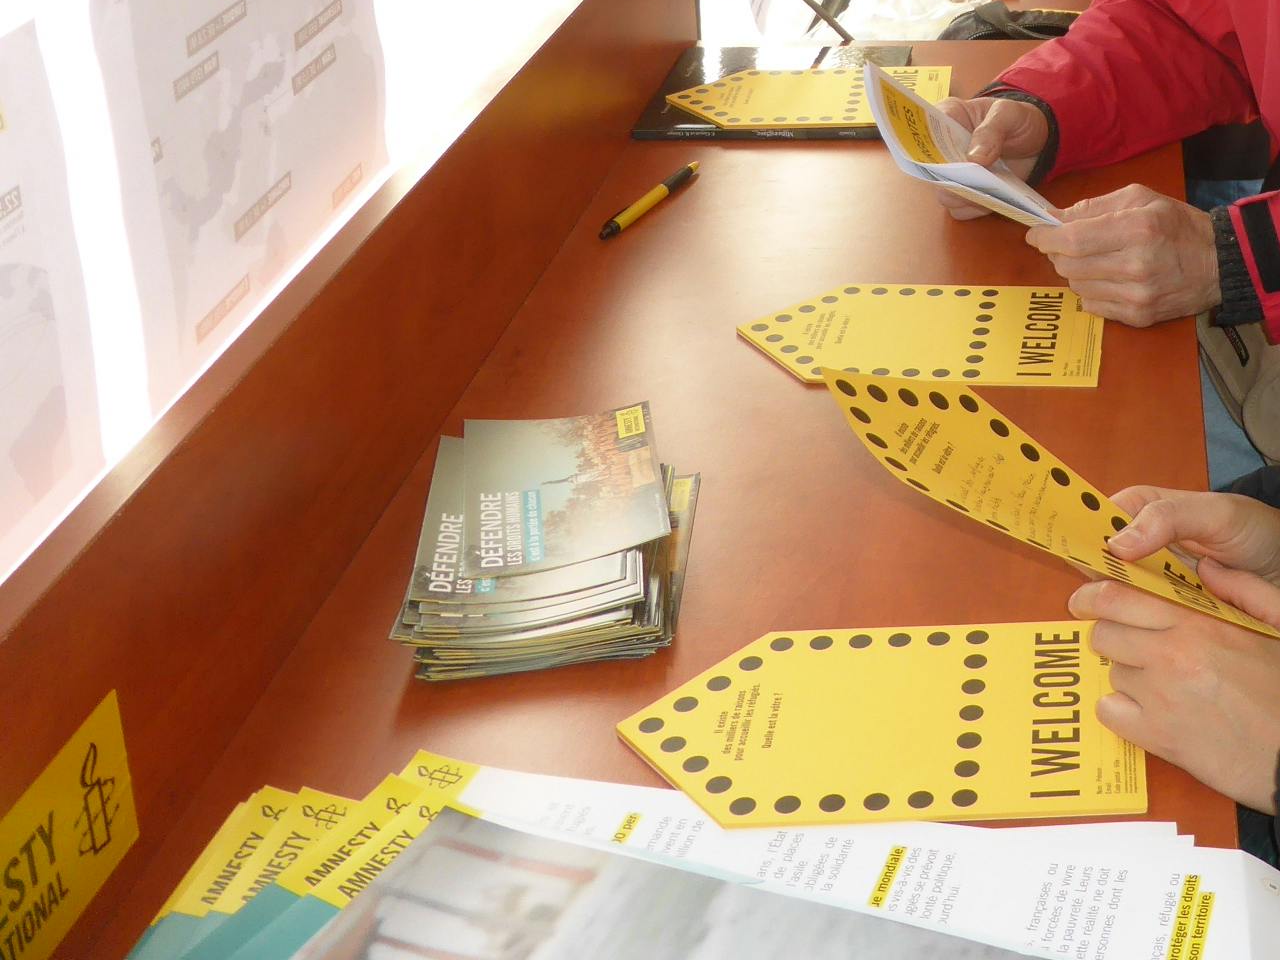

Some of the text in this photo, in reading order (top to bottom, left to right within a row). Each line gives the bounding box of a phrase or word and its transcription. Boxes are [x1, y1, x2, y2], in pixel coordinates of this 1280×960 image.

[1018, 290, 1065, 369] WELCOME
[425, 512, 465, 593] DÉFENDRE
[475, 492, 504, 568] DÉFENDRE
[505, 491, 523, 566] LES DROITS HUMAINS
[455, 578, 473, 594] LES
[717, 711, 728, 728] existe
[721, 690, 747, 754] des milliers de raisons
[734, 683, 761, 761] pour accueillir les réfugiés.
[768, 720, 777, 729] est
[770, 697, 782, 712] vôtre
[1030, 630, 1082, 798] I WELCOME
[761, 730, 775, 749] Quelle
[200, 831, 264, 906] AMNESTY
[304, 821, 381, 888] AMNESTY
[337, 829, 416, 902] AMNESTY
[774, 833, 805, 879] de places
[820, 839, 855, 892] la solidarité
[824, 836, 838, 849] de
[877, 846, 908, 893] mondiale,
[907, 847, 922, 864] des
[919, 849, 940, 880] prévoit
[914, 881, 926, 893] se
[1026, 862, 1059, 931] françaises ou
[1041, 864, 1076, 942] forcées de vivre
[1057, 944, 1070, 953] la
[1074, 866, 1094, 893] Leurs
[1076, 867, 1112, 960] ette réalité ne doit
[1095, 868, 1129, 960] ersonnes dont les
[1159, 890, 1177, 927] réfugié
[1169, 873, 1181, 886] ou
[1181, 904, 1192, 919] les
[1184, 874, 1198, 903] droits
[1191, 891, 1213, 940] territoire.
